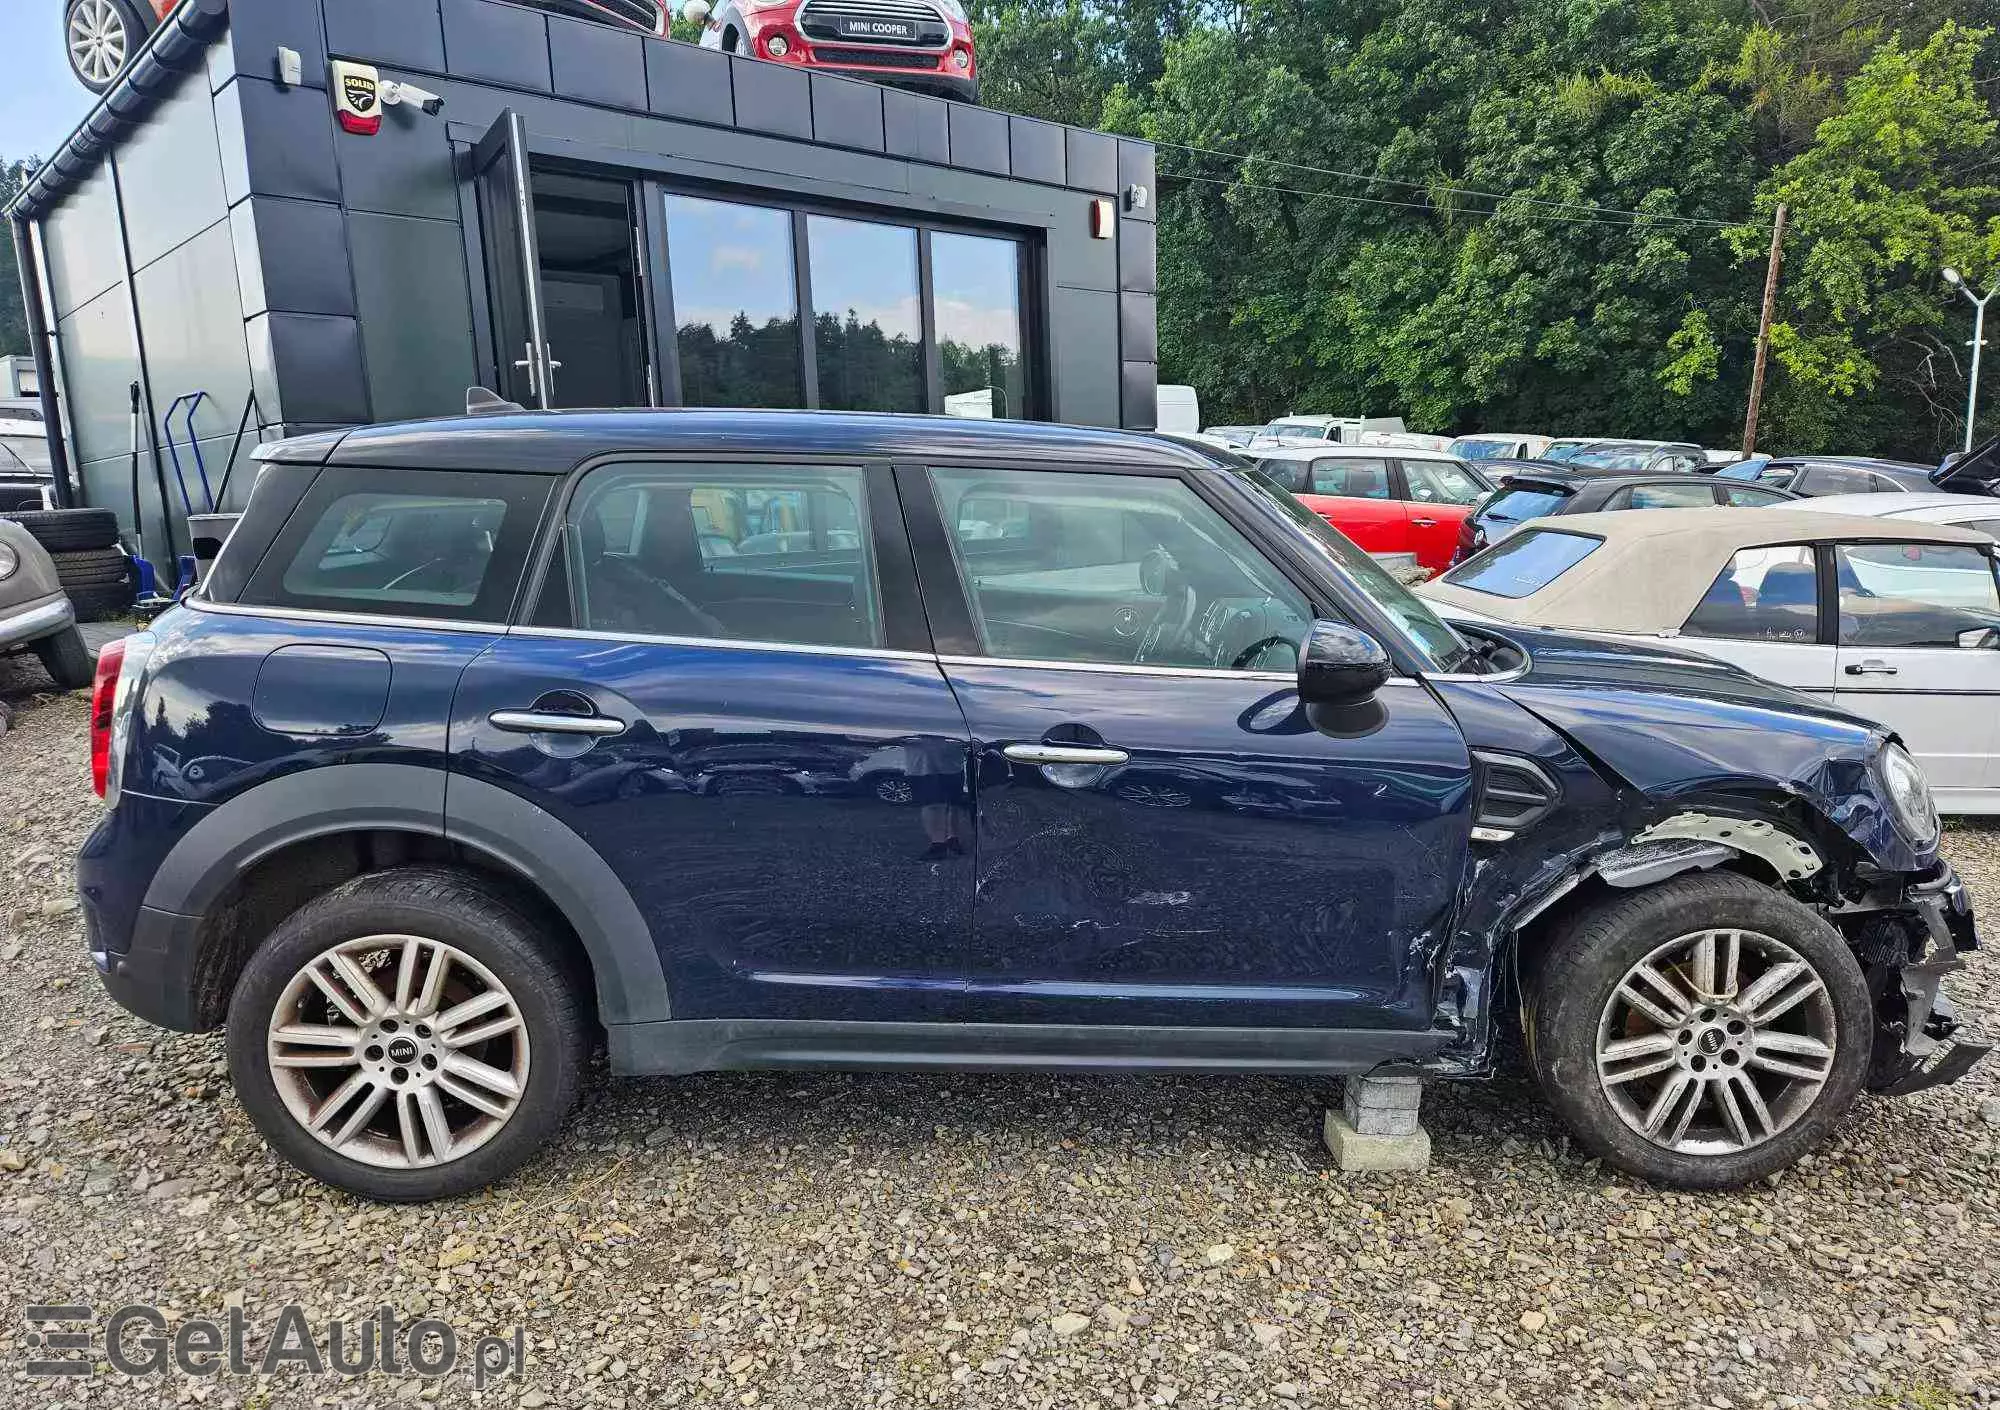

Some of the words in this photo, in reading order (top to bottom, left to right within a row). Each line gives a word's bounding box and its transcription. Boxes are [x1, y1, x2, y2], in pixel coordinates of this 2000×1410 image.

[849, 21, 870, 32] MINI
[872, 22, 907, 35] COOPER
[345, 78, 374, 90] SOLID
[391, 1047, 413, 1056] MINI
